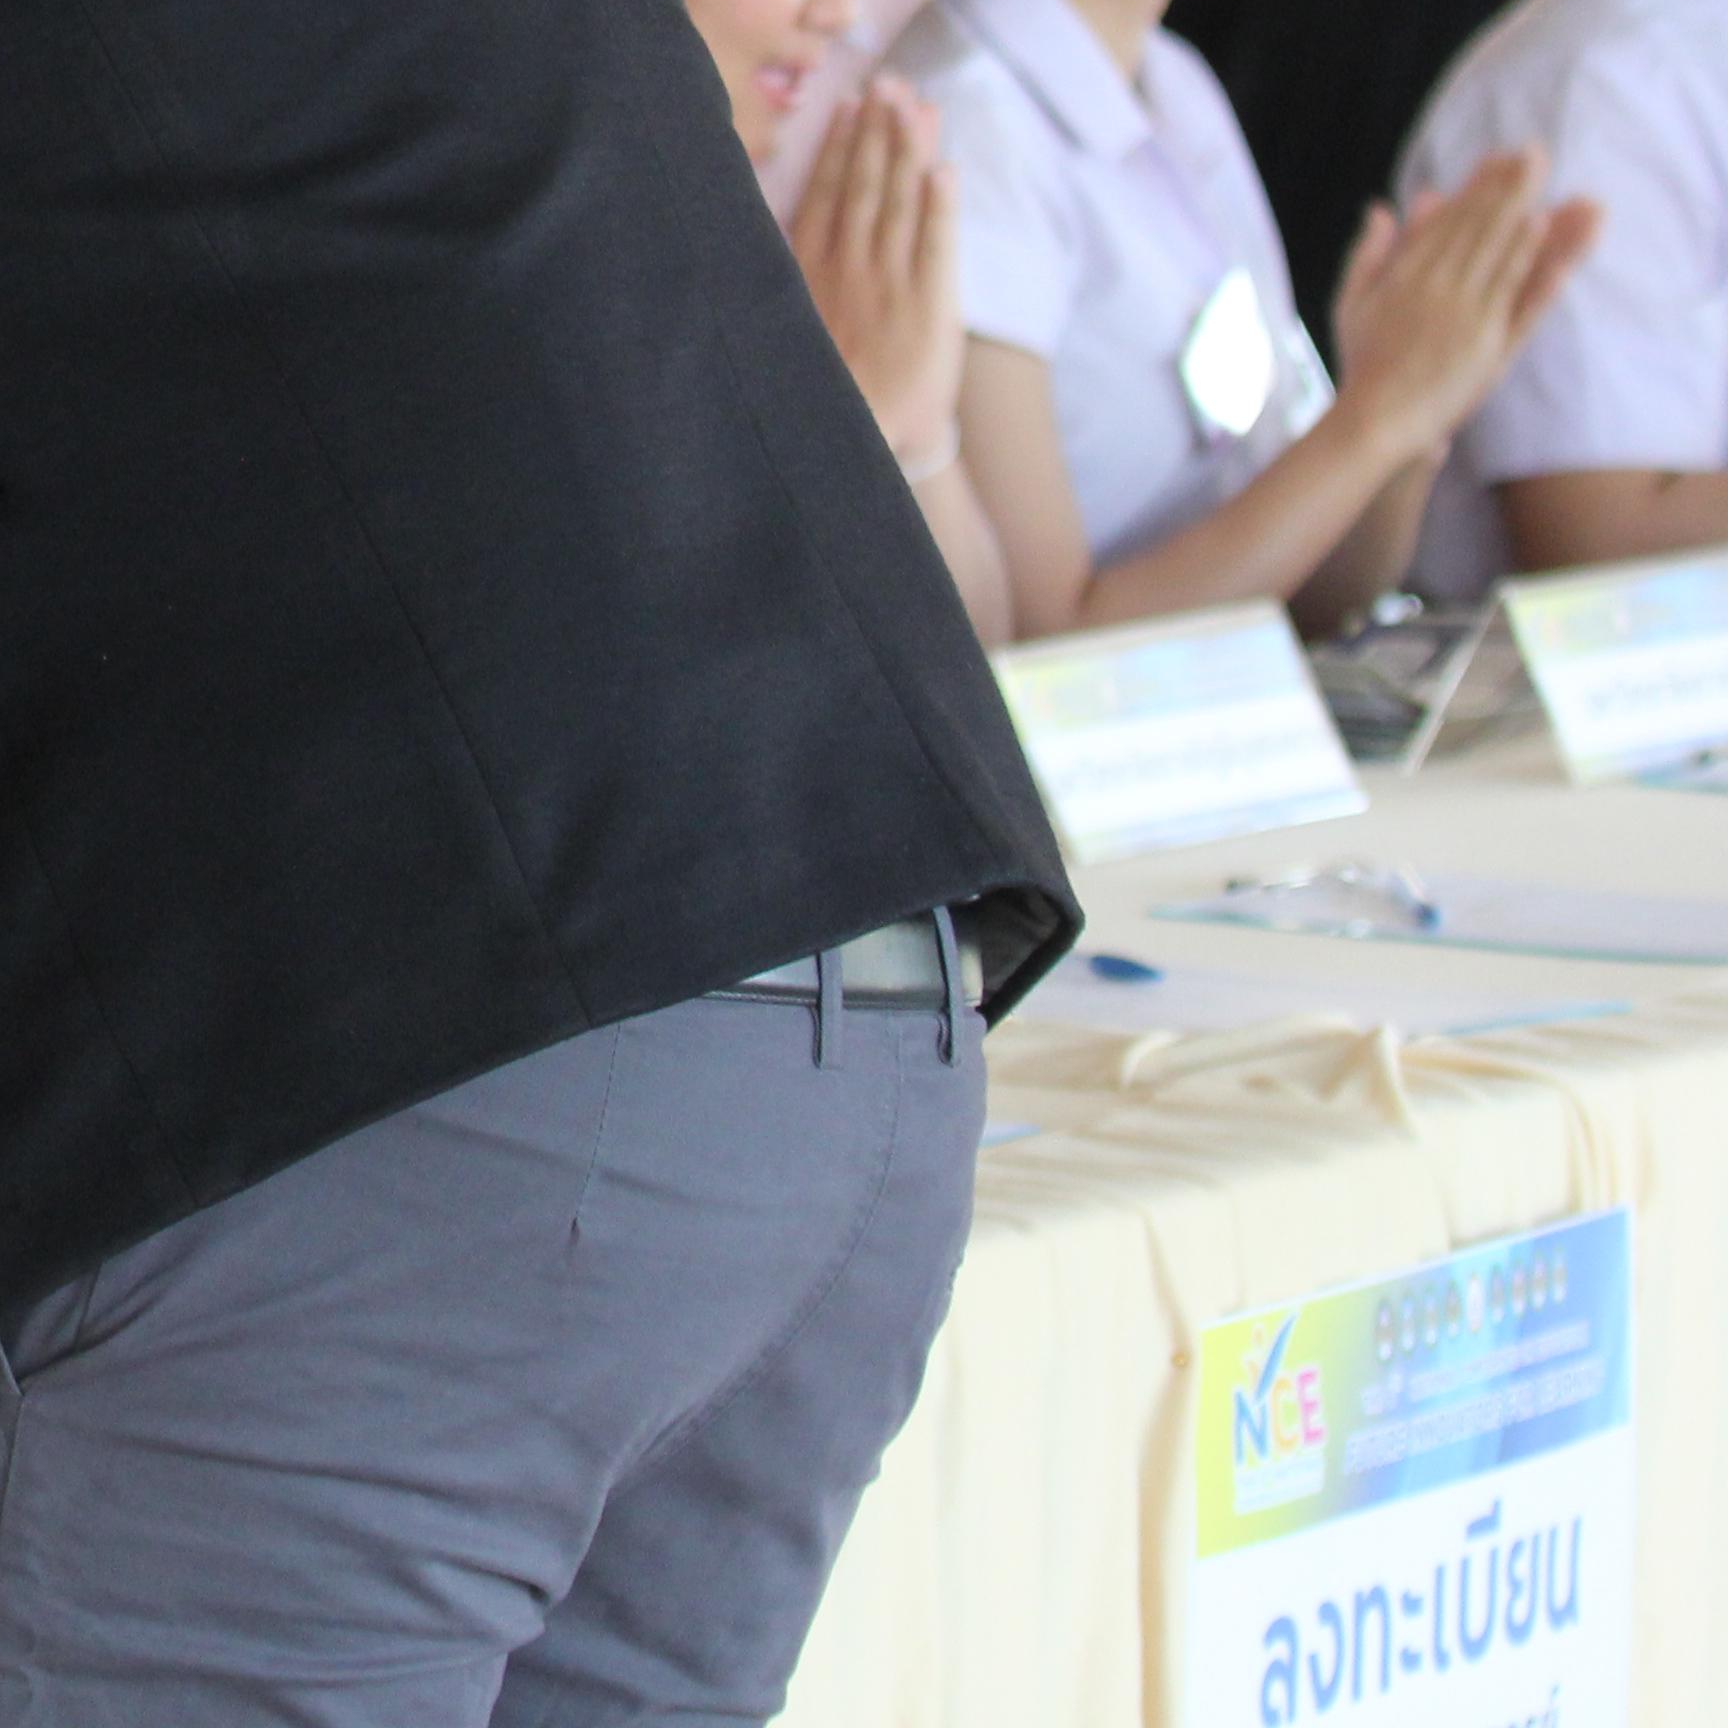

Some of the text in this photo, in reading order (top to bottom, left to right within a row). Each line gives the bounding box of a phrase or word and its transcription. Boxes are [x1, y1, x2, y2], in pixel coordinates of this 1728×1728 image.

[1234, 1368, 1325, 1464] NCE
[1261, 1498, 1580, 1728] ลงทะเบียน
